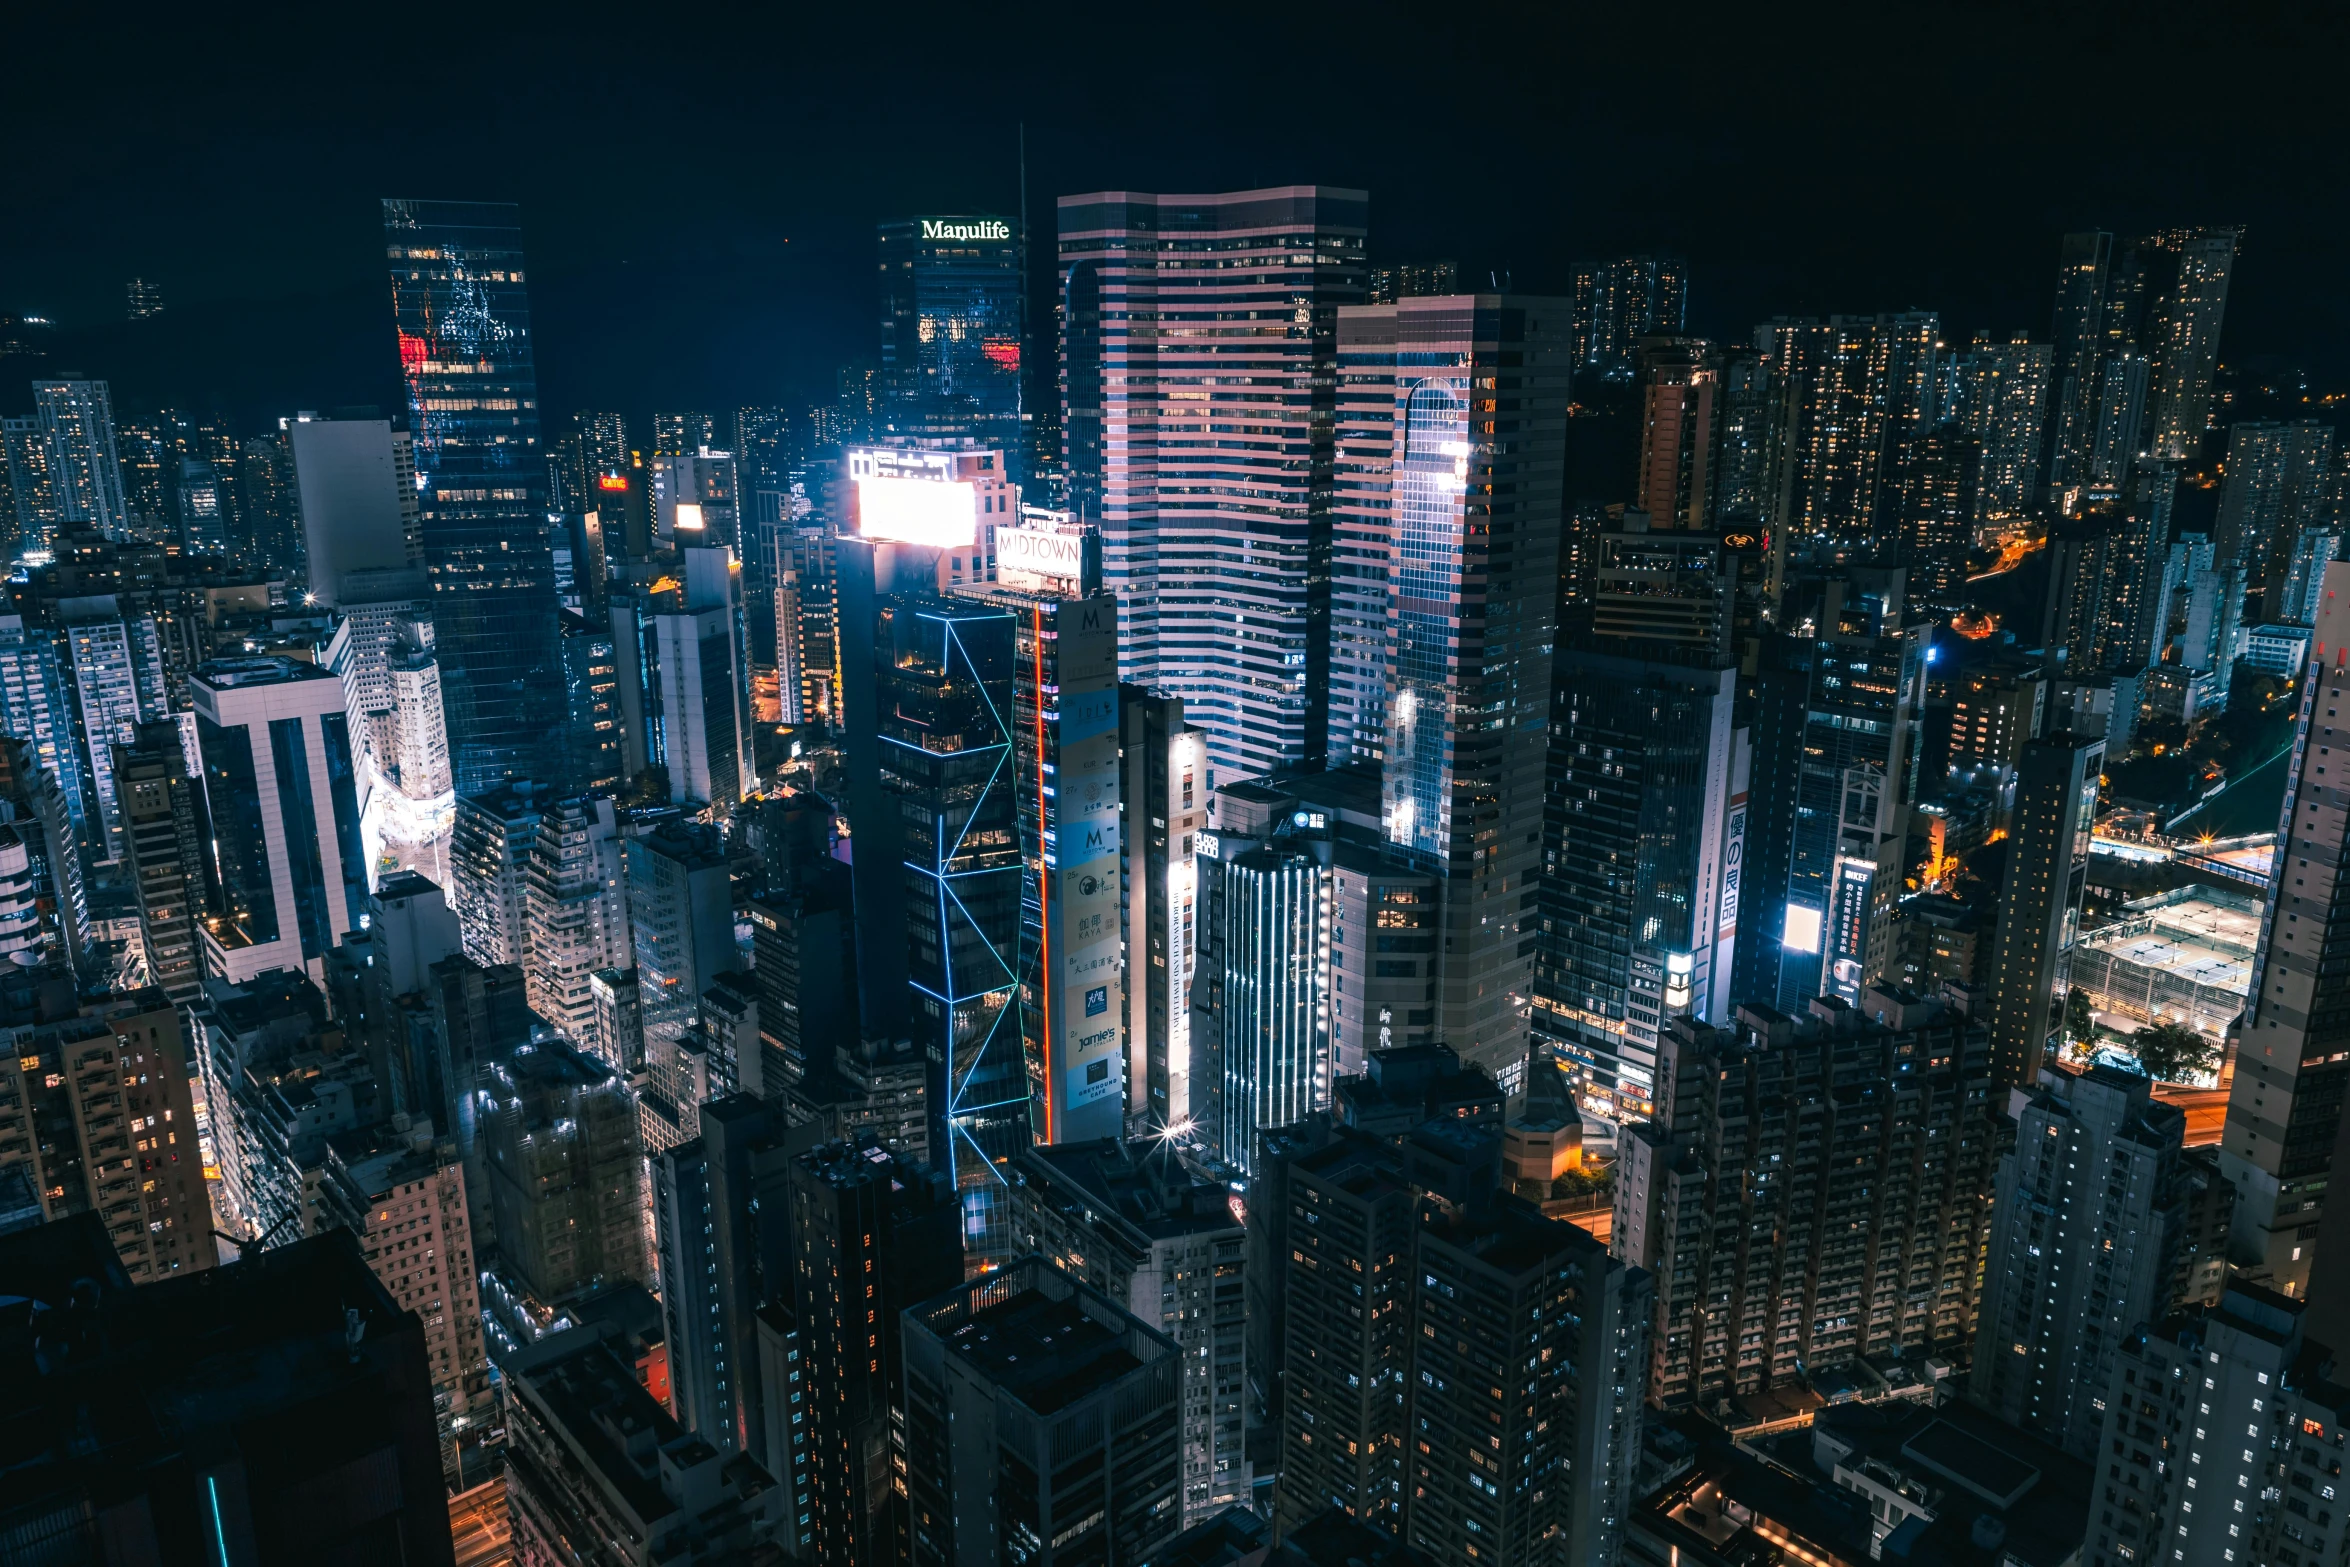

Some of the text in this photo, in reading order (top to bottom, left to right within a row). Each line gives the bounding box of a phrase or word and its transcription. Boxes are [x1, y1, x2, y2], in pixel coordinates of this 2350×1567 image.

[922, 220, 1010, 241] Manulife
[1000, 534, 1079, 562] MIDTOWN
[1082, 608, 1100, 631] M
[1086, 828, 1103, 848] M
[1195, 831, 1219, 849] PLAZA
[1722, 812, 1745, 922] 優の良品
[1078, 928, 1102, 940] KAYA
[1078, 1027, 1115, 1052] Jamie's
[1094, 1037, 1115, 1048] ITALIAN
[1078, 1078, 1118, 1097] GREYHOUND
